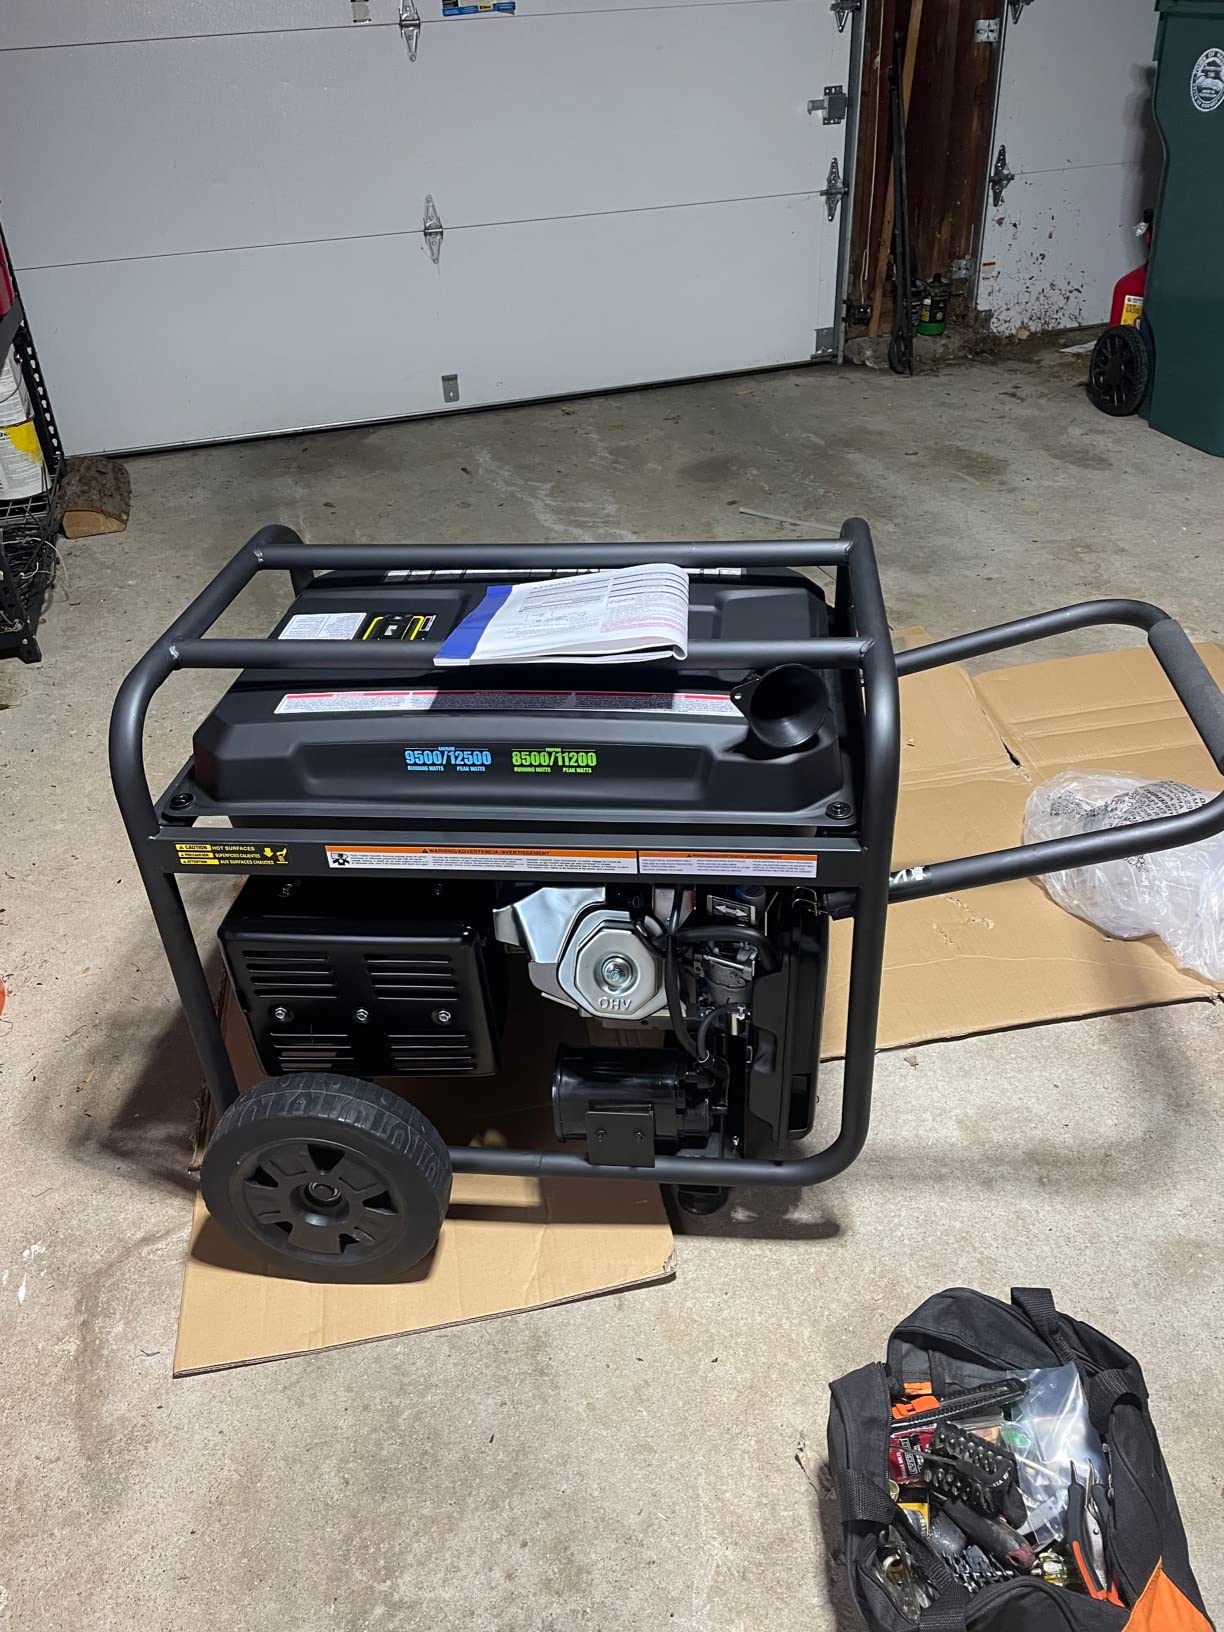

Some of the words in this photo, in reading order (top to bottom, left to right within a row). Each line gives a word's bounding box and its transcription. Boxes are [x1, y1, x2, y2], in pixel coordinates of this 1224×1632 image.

[404, 750, 492, 764] 9500/12500
[512, 752, 596, 766] 8500/11200
[598, 997, 632, 1010] OHV
